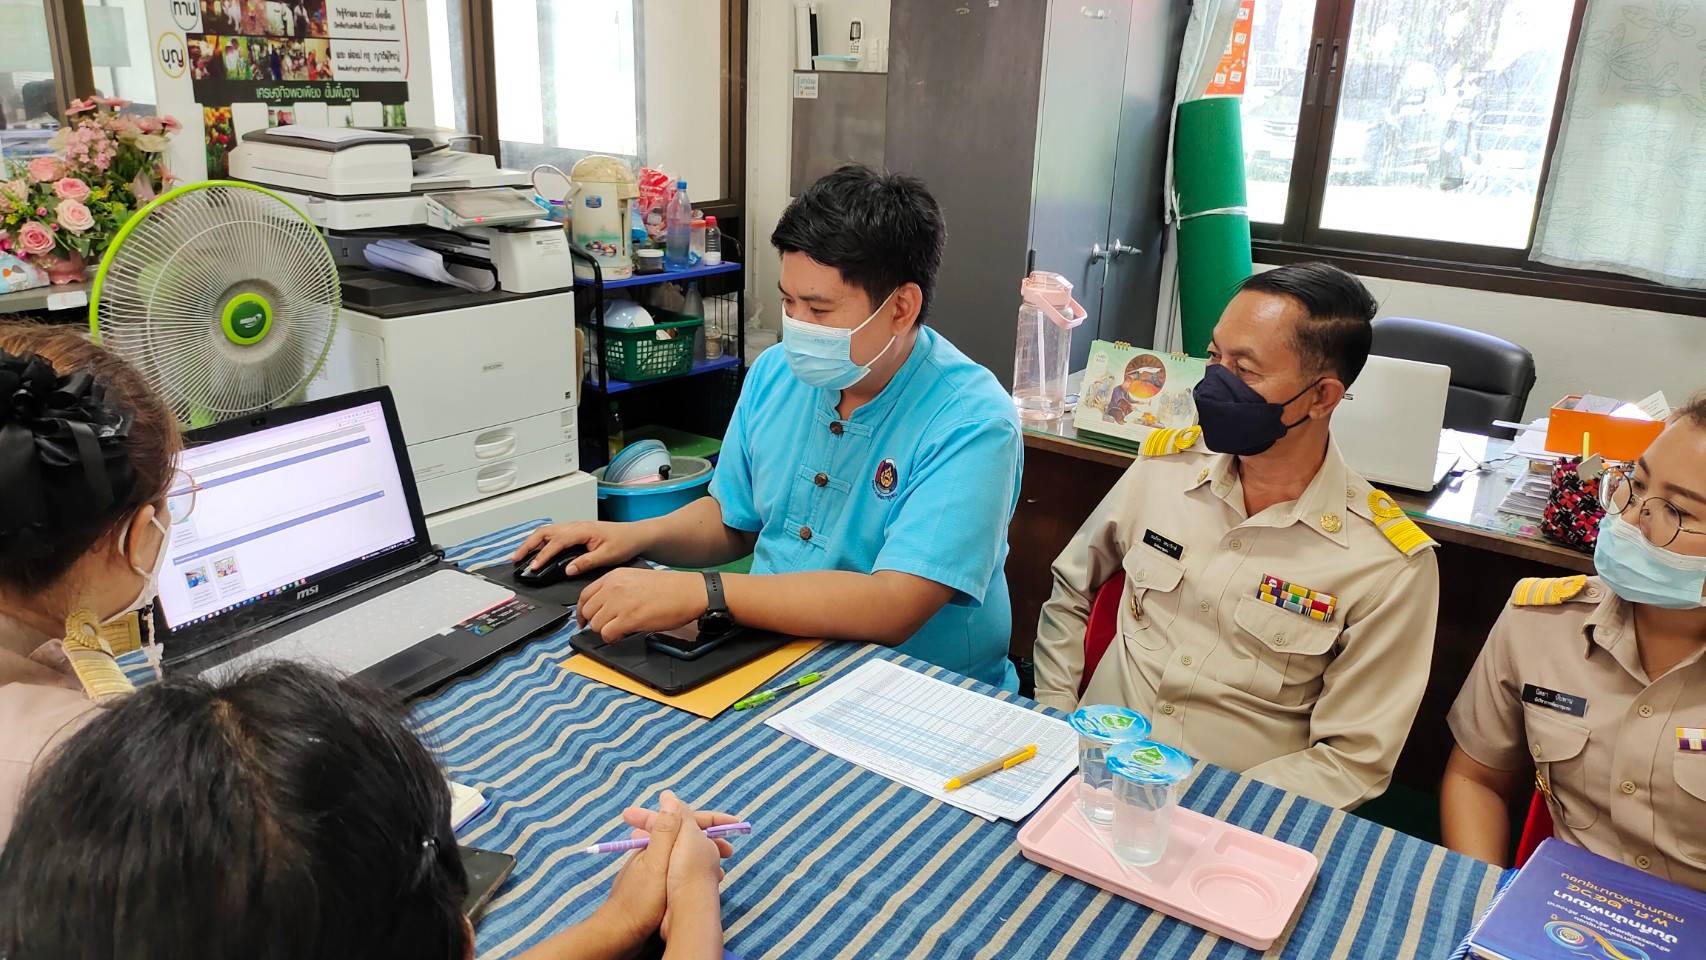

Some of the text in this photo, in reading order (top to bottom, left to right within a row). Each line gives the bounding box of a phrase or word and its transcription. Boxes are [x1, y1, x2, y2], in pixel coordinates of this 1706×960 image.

[173, 1, 197, 17] ทาน
[161, 49, 185, 70] บุญ
[256, 82, 360, 102] เศรษฐกิจพอเพียง ขั้นพื้นฐาน
[296, 585, 319, 600] msi
[1561, 872, 1684, 923] กรมการพัฒนาชุมชน
[1553, 889, 1678, 944] บันทึกนักพัฒนา
[1632, 908, 1668, 928] พ.ศ.
